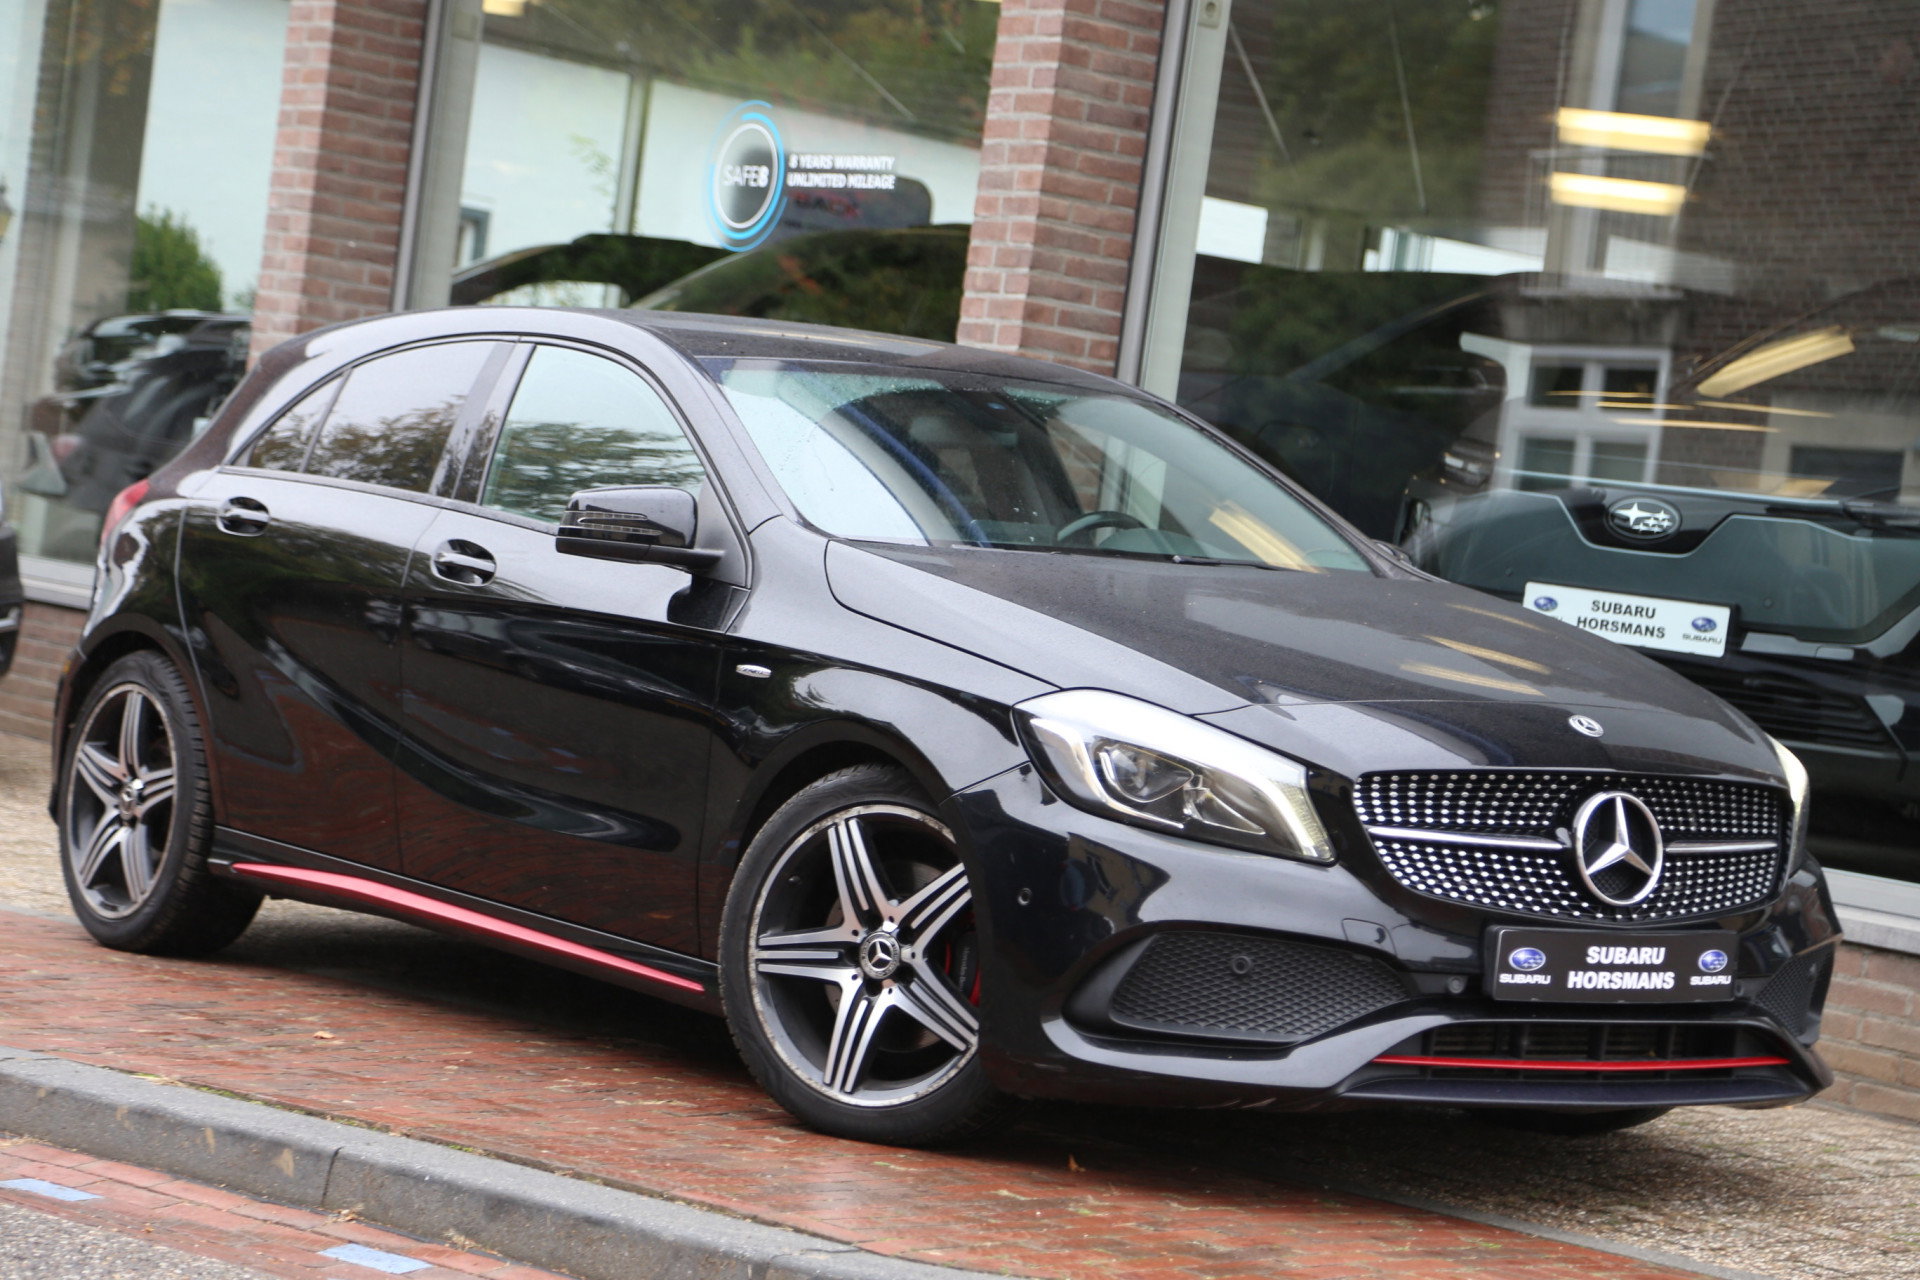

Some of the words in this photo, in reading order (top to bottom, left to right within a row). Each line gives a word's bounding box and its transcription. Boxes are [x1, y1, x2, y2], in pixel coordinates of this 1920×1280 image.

[800, 154, 834, 169] YEARS
[834, 155, 896, 170] WARRANTY
[722, 165, 770, 188] SAFE8
[786, 171, 847, 188] UNLIMITED
[847, 173, 896, 189] MILEAGE
[1591, 600, 1657, 619] SUBARU
[1576, 616, 1666, 639] HORSMANS
[1682, 633, 1723, 645] SUBARU
[1585, 945, 1667, 965] SUBARU
[1499, 973, 1551, 985] SUBARU
[1566, 970, 1676, 989] HORSMANS
[1689, 975, 1732, 986] SUBARU
